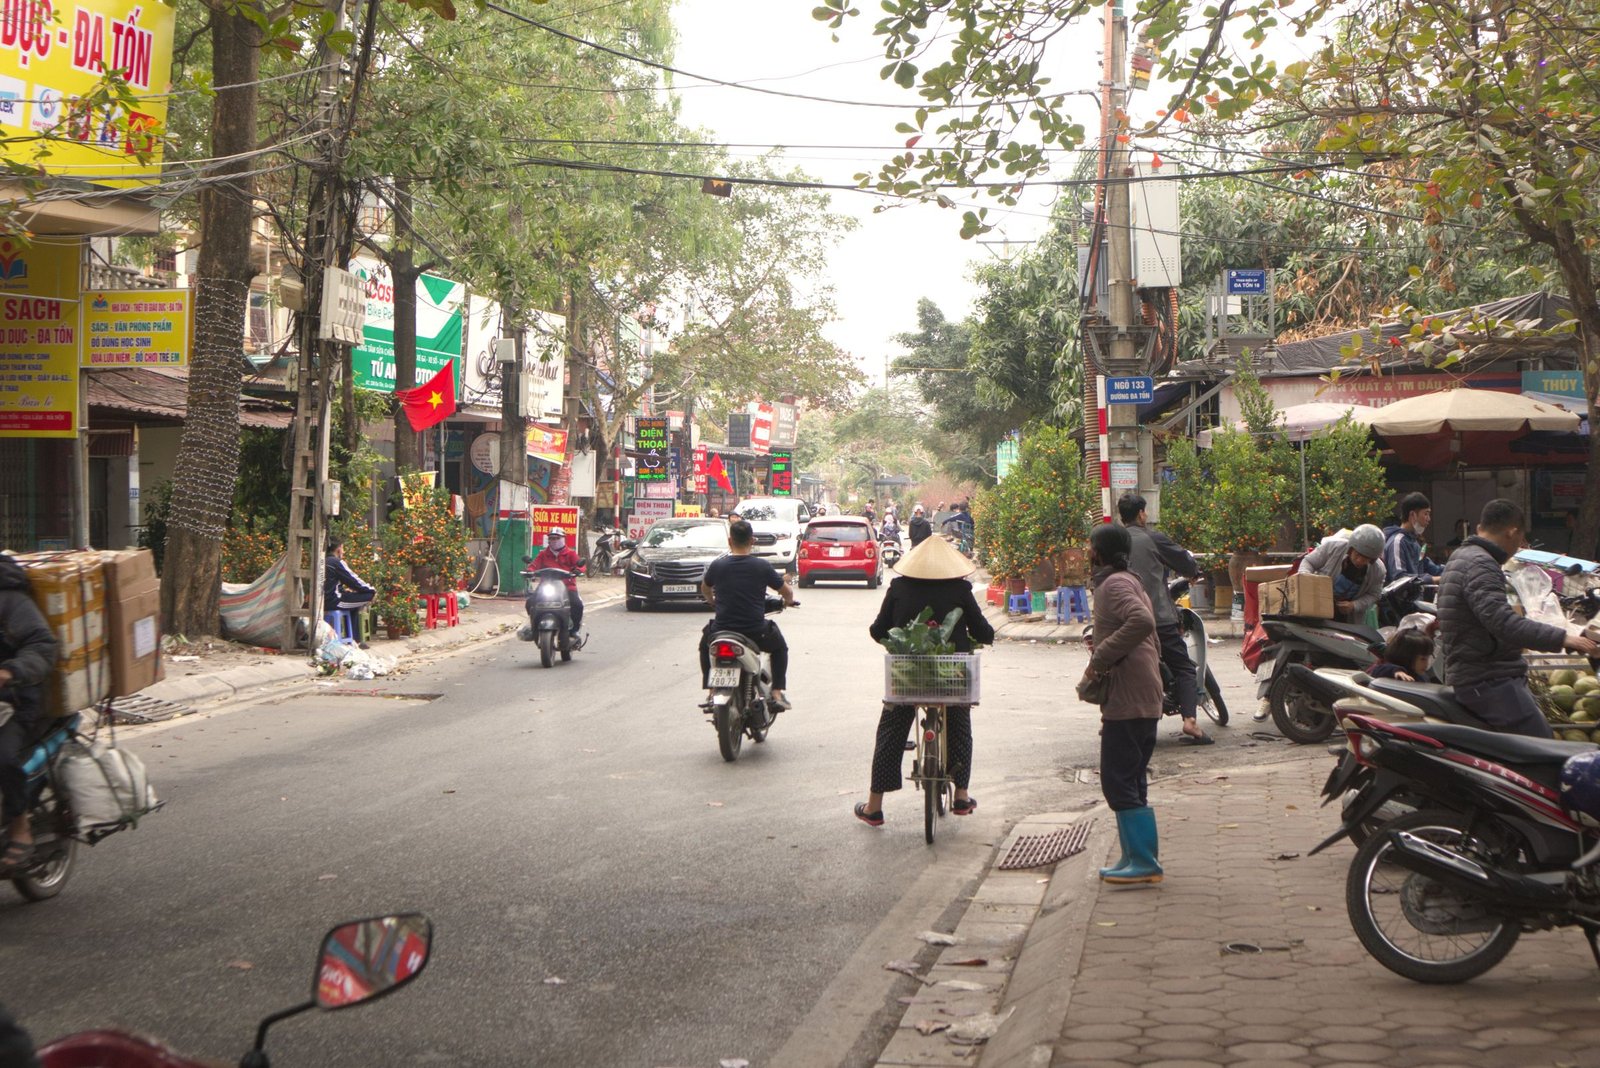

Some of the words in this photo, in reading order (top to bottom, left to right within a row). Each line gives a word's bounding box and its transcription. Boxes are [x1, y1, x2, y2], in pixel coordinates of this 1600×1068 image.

[2, 0, 51, 65] DỤC
[74, 10, 103, 73] ĐA
[112, 9, 152, 87] TỐN
[8, 328, 28, 347] DỤC
[38, 328, 50, 344] ĐA
[54, 323, 73, 344] TỐN
[121, 338, 134, 349] HỌC
[135, 338, 151, 346] SINH
[171, 353, 179, 362] EM
[384, 362, 396, 379] AN
[1114, 380, 1129, 390] NGÕ
[1132, 381, 1145, 389] 133
[1139, 391, 1150, 399] TỐN
[640, 427, 663, 440] ĐIỆN
[637, 440, 667, 450] THOẠI
[550, 512, 559, 523] XE
[561, 510, 576, 524] MÁY
